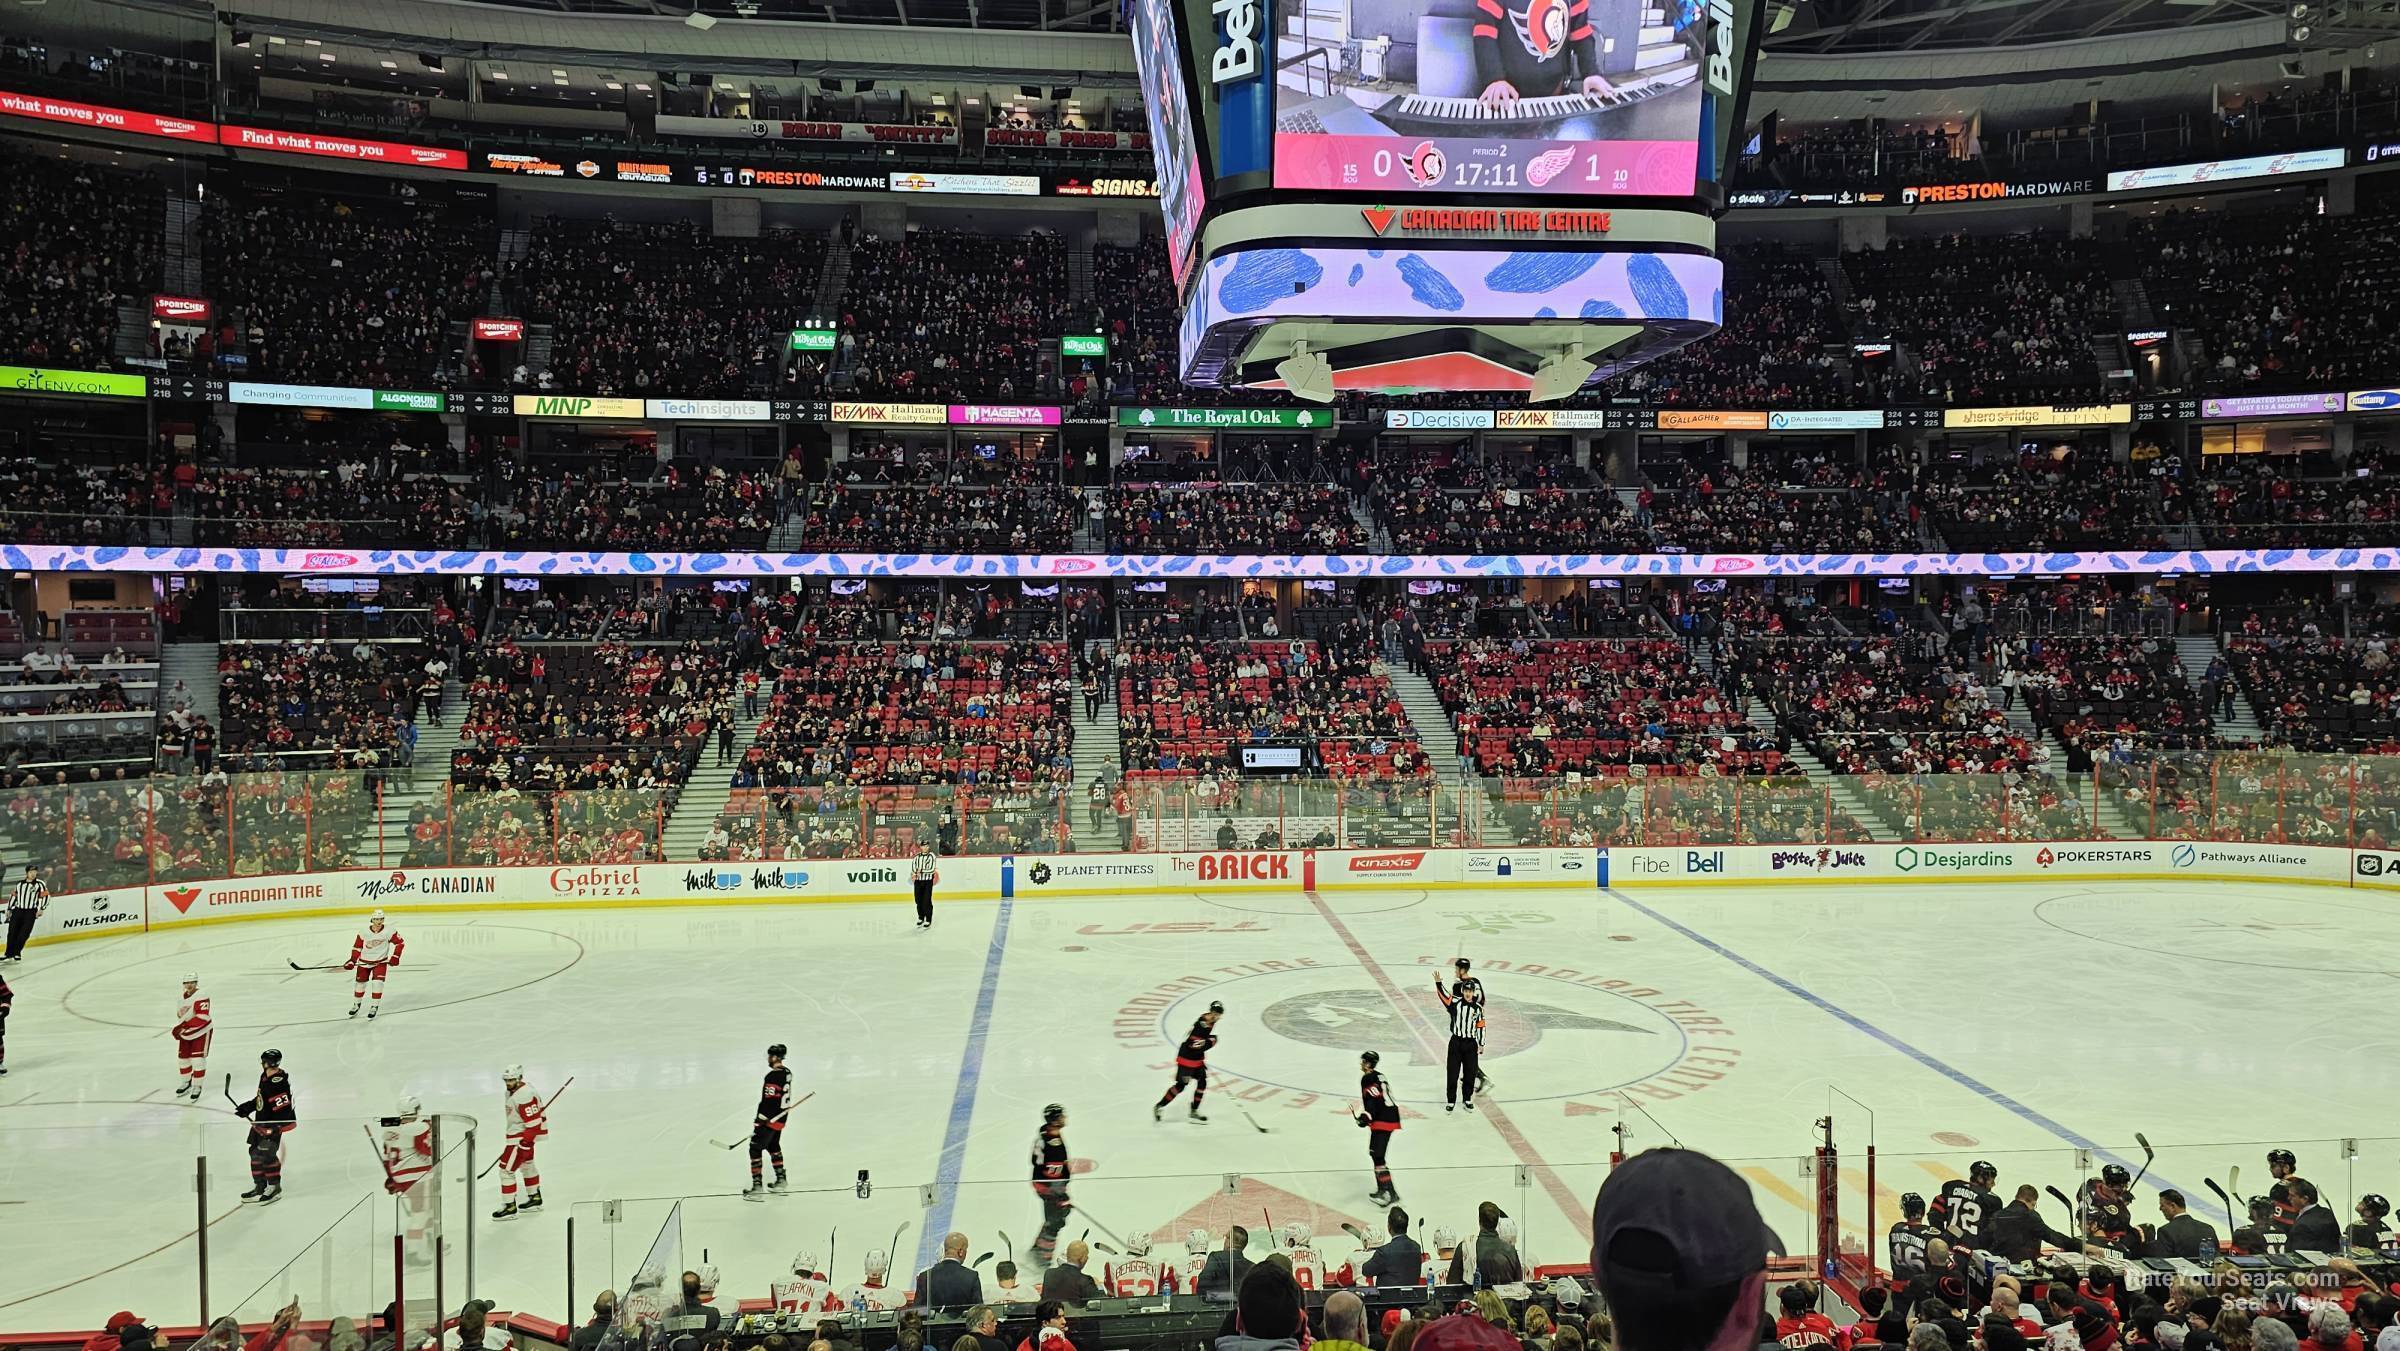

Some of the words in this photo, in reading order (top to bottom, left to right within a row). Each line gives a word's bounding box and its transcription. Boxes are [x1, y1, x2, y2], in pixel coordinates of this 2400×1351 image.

[1709, 0, 1733, 95] Bell
[2, 96, 41, 113] what
[45, 104, 93, 123] moves
[96, 113, 125, 129] you
[752, 124, 765, 134] 18
[781, 122, 843, 140] BRIAN
[242, 129, 274, 145] Find
[277, 134, 312, 150] what
[314, 138, 357, 154] moves
[359, 143, 385, 158] you
[986, 130, 1048, 148] SMITH
[1060, 133, 1117, 148] PRESS
[1473, 149, 1500, 158] PERIOD
[1500, 145, 1508, 158] 2
[1373, 149, 1391, 177] 0
[1585, 153, 1601, 183] 1
[1343, 163, 1358, 176] 15
[1455, 163, 1519, 187] 17:11
[1613, 169, 1629, 182] 10
[697, 171, 708, 183] 15
[724, 172, 733, 184] 10
[1401, 208, 1498, 231] CANADIAN
[1501, 211, 1541, 233] TIRE
[1546, 211, 1610, 233] CENTRE
[158, 299, 206, 312] SPORTCHEK
[479, 322, 519, 332] SPORTCHEK
[153, 377, 173, 387] 318
[205, 380, 224, 390] 319
[153, 389, 173, 399] 218
[205, 392, 224, 402] 219
[243, 389, 292, 403] Changing
[294, 391, 358, 404] Communities
[381, 393, 438, 404] ALGONQUIN
[450, 394, 465, 402] 319
[491, 395, 509, 403] 320
[535, 397, 592, 415] MNP
[774, 402, 791, 410] 320
[813, 402, 828, 410] 321
[2178, 401, 2196, 410] 326
[2226, 398, 2241, 406] GET
[2278, 396, 2302, 404] TODAY
[2351, 396, 2386, 408] mattamy
[450, 405, 466, 413] 219
[491, 406, 509, 414] 220
[661, 401, 757, 419] TechInsights
[833, 404, 887, 421] RE/MAX
[891, 404, 944, 416] Hallmark
[982, 408, 1043, 419] MAGENTA
[2138, 403, 2155, 412] 325
[774, 412, 791, 421] 220
[813, 413, 828, 421] 221
[1170, 409, 1200, 425] The
[1205, 410, 1248, 428] Royal
[1250, 410, 1281, 424] Oak
[1412, 411, 1487, 428] Decisive
[1499, 412, 1550, 427] RE/MAX
[1552, 411, 1600, 421] Hallmark
[1606, 410, 1622, 419] 323
[1640, 410, 1655, 419] 324
[1669, 413, 1720, 425] GALLAGHER
[1887, 410, 1903, 418] 324
[1923, 410, 1939, 418] 325
[2138, 412, 2154, 421] 225
[2178, 410, 2196, 419] 226
[1064, 417, 1089, 426] CAMERA
[1090, 418, 1108, 426] STAND
[1606, 420, 1621, 429] 223
[1640, 420, 1654, 429] 224
[1887, 419, 1903, 428] 224
[1923, 419, 1939, 428] 225
[1093, 788, 1106, 800] 28
[1686, 851, 1724, 873] Bell
[1772, 852, 1816, 870] Booster
[1830, 851, 1866, 869] Juice
[1924, 852, 2013, 870] Desjardins
[2056, 850, 2152, 862] POKERSTARS
[2200, 851, 2256, 865] Pathways
[2258, 853, 2307, 866] Alliance
[1171, 857, 1195, 871] The
[1198, 855, 1288, 880] BRICK
[1468, 857, 1492, 868] Ford
[1632, 856, 1670, 873] Fibe
[847, 868, 898, 884] voilà
[1057, 866, 1104, 876] PLANET
[1106, 865, 1154, 875] FITNESS
[550, 866, 641, 892] Gabriel
[357, 876, 416, 900] Molson
[421, 876, 497, 894] CANADIAN
[578, 888, 641, 897] PIZZA
[209, 887, 288, 906] CANADIAN
[292, 884, 323, 899] TIRE
[63, 913, 139, 929] NHLSHOP.CA
[1213, 955, 1321, 984] TIRE
[275, 1094, 289, 1107] 23
[525, 1103, 539, 1118] 96
[1947, 1196, 1983, 1236] 72
[1115, 1260, 1158, 1280] BERGGREN
[782, 1282, 816, 1298] LARKIN
